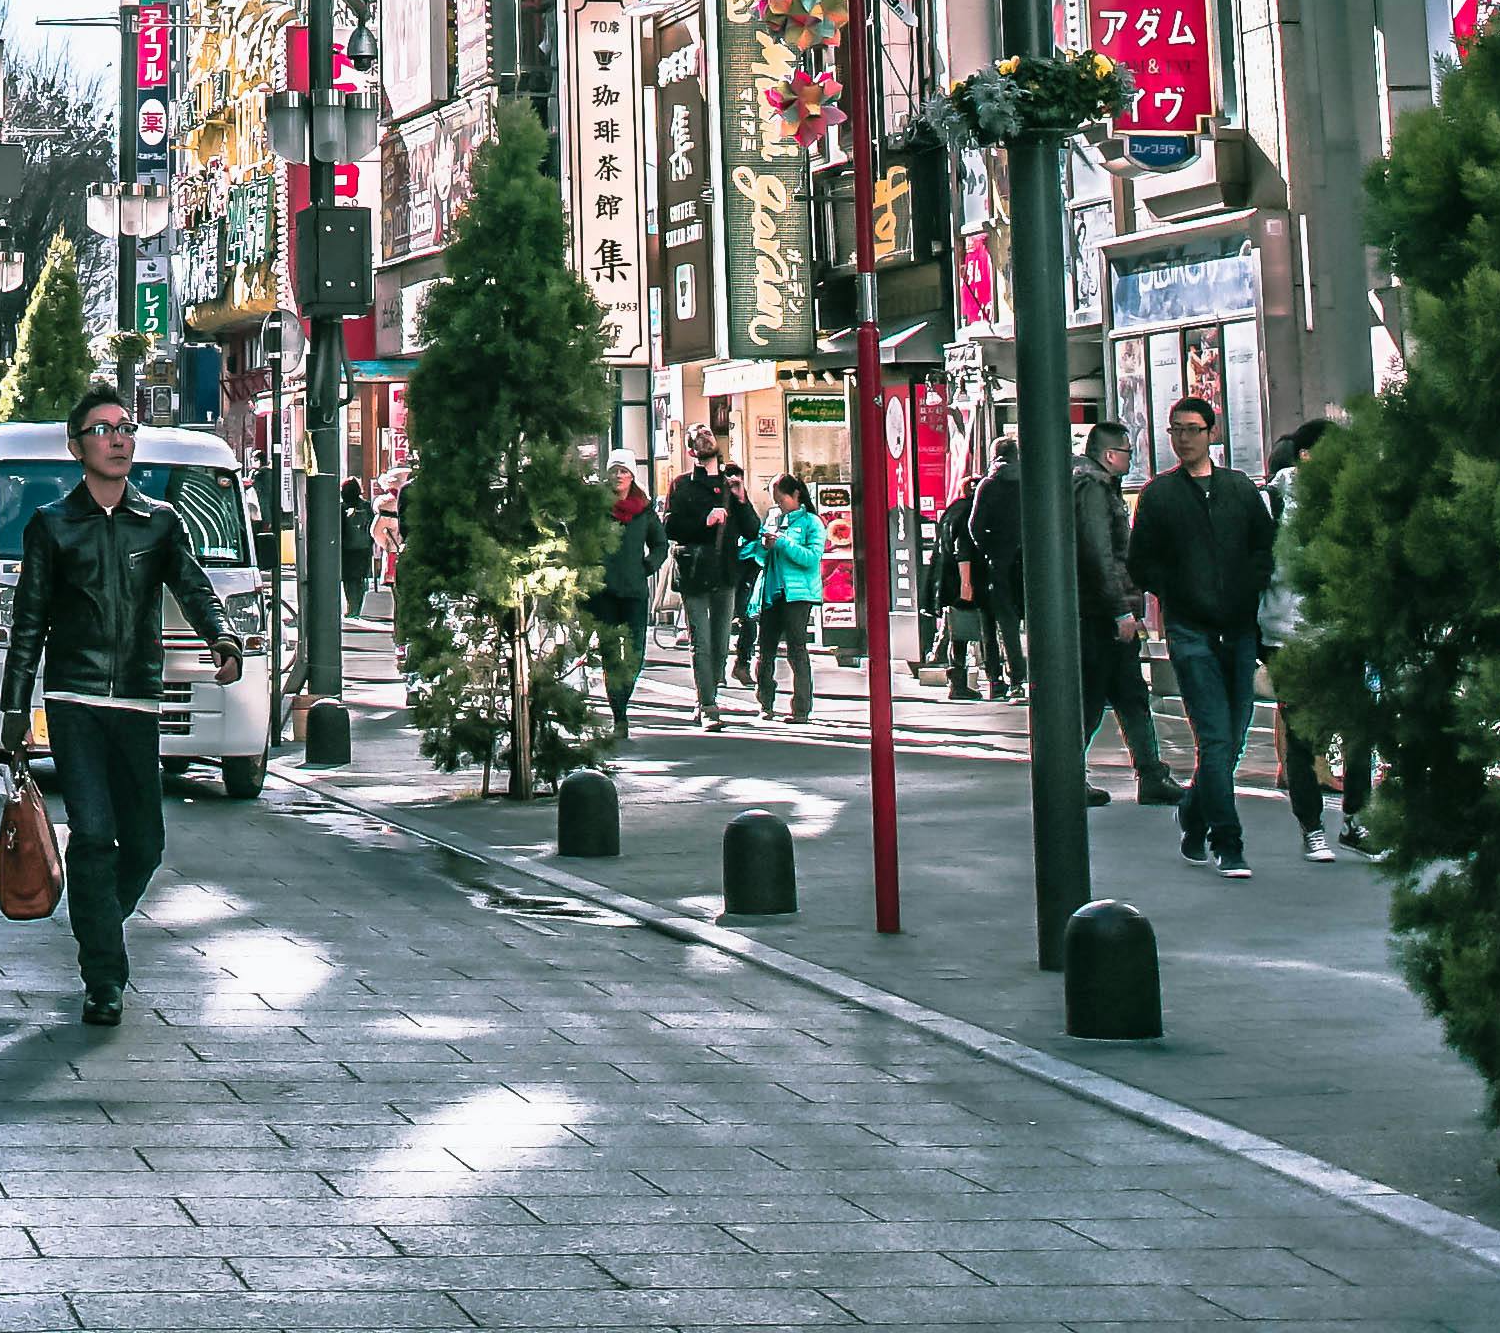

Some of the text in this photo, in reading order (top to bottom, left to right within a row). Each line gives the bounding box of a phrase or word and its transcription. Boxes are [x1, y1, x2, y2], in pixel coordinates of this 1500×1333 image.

[143, 9, 163, 82] アイフル
[1099, 8, 1196, 47] アダム
[140, 111, 164, 134] 薬
[591, 84, 624, 221] 珈琲茶館
[589, 238, 633, 284] 集
